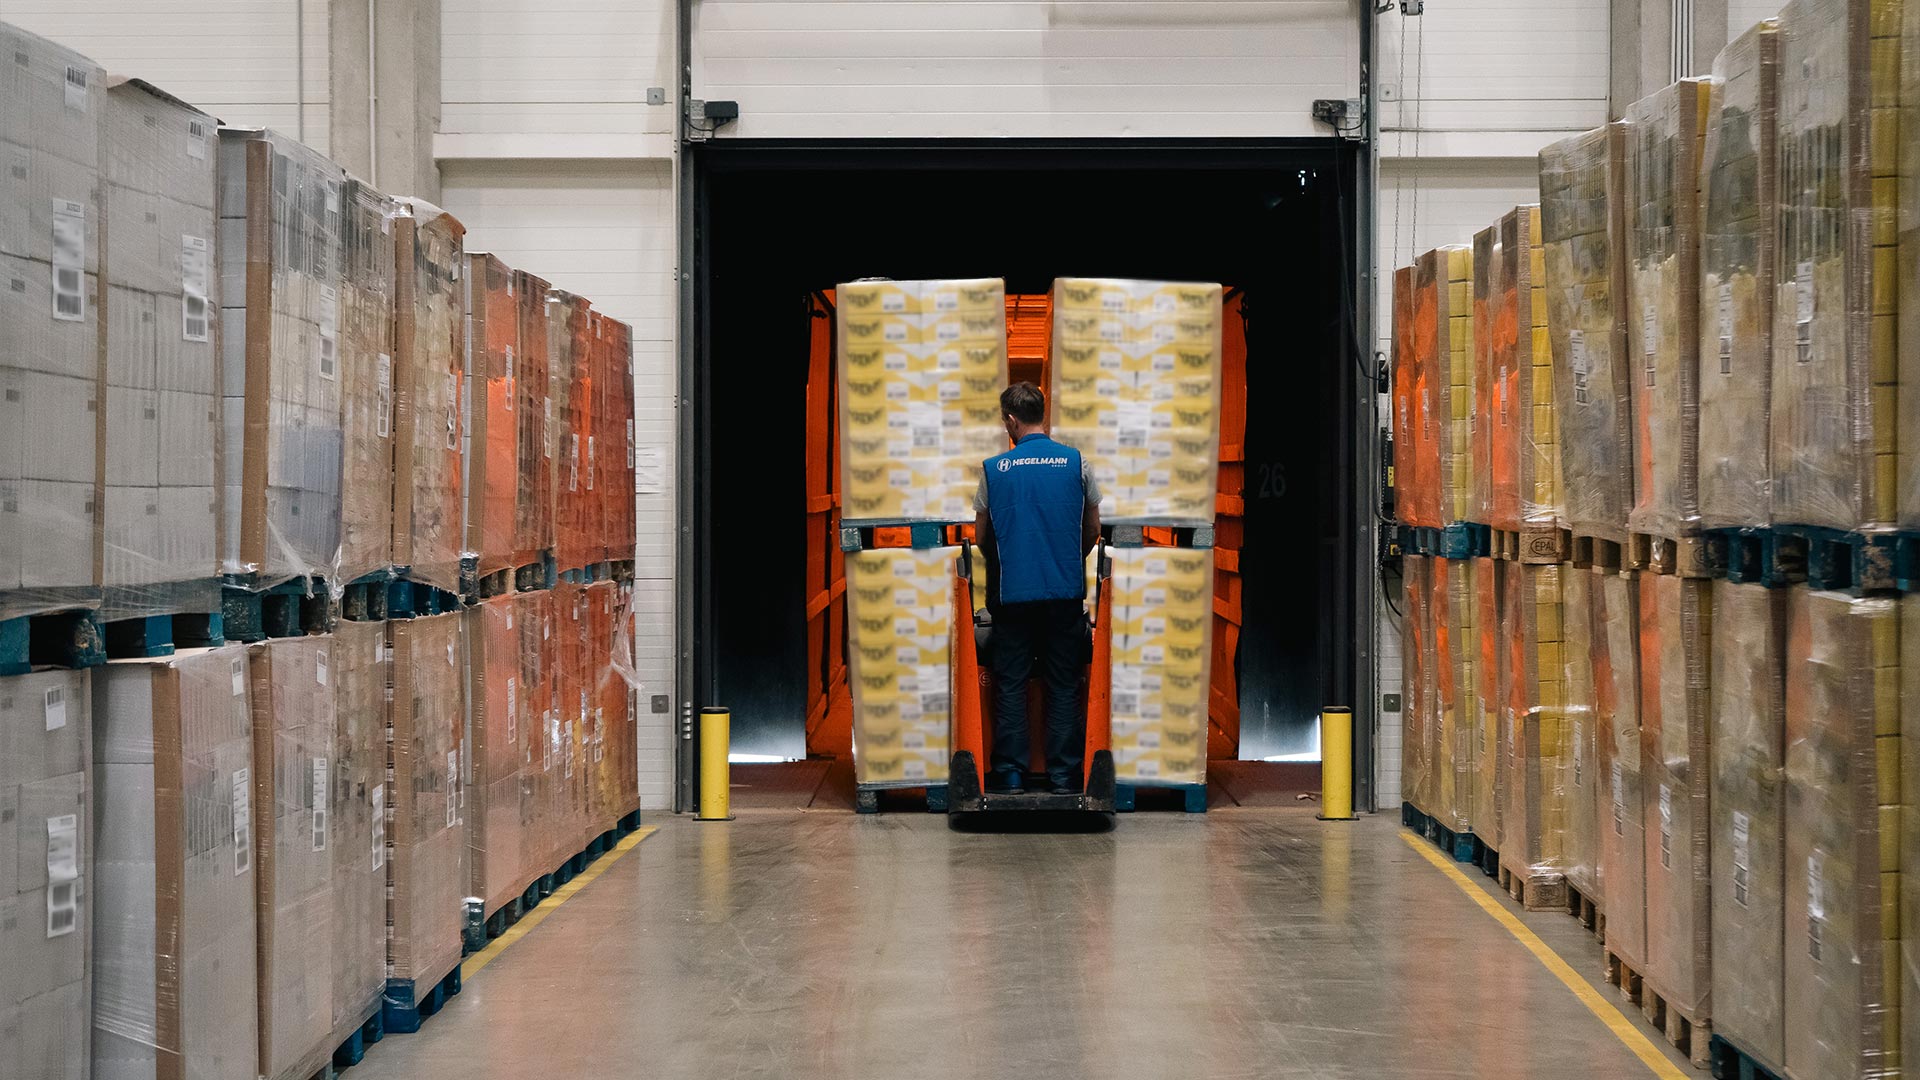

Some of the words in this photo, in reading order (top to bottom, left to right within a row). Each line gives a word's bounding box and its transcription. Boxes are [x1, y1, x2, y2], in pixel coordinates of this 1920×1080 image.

[1012, 457, 1068, 466] HEGELMANN
[1259, 463, 1286, 498] 26
[1535, 541, 1555, 551] EPAL
